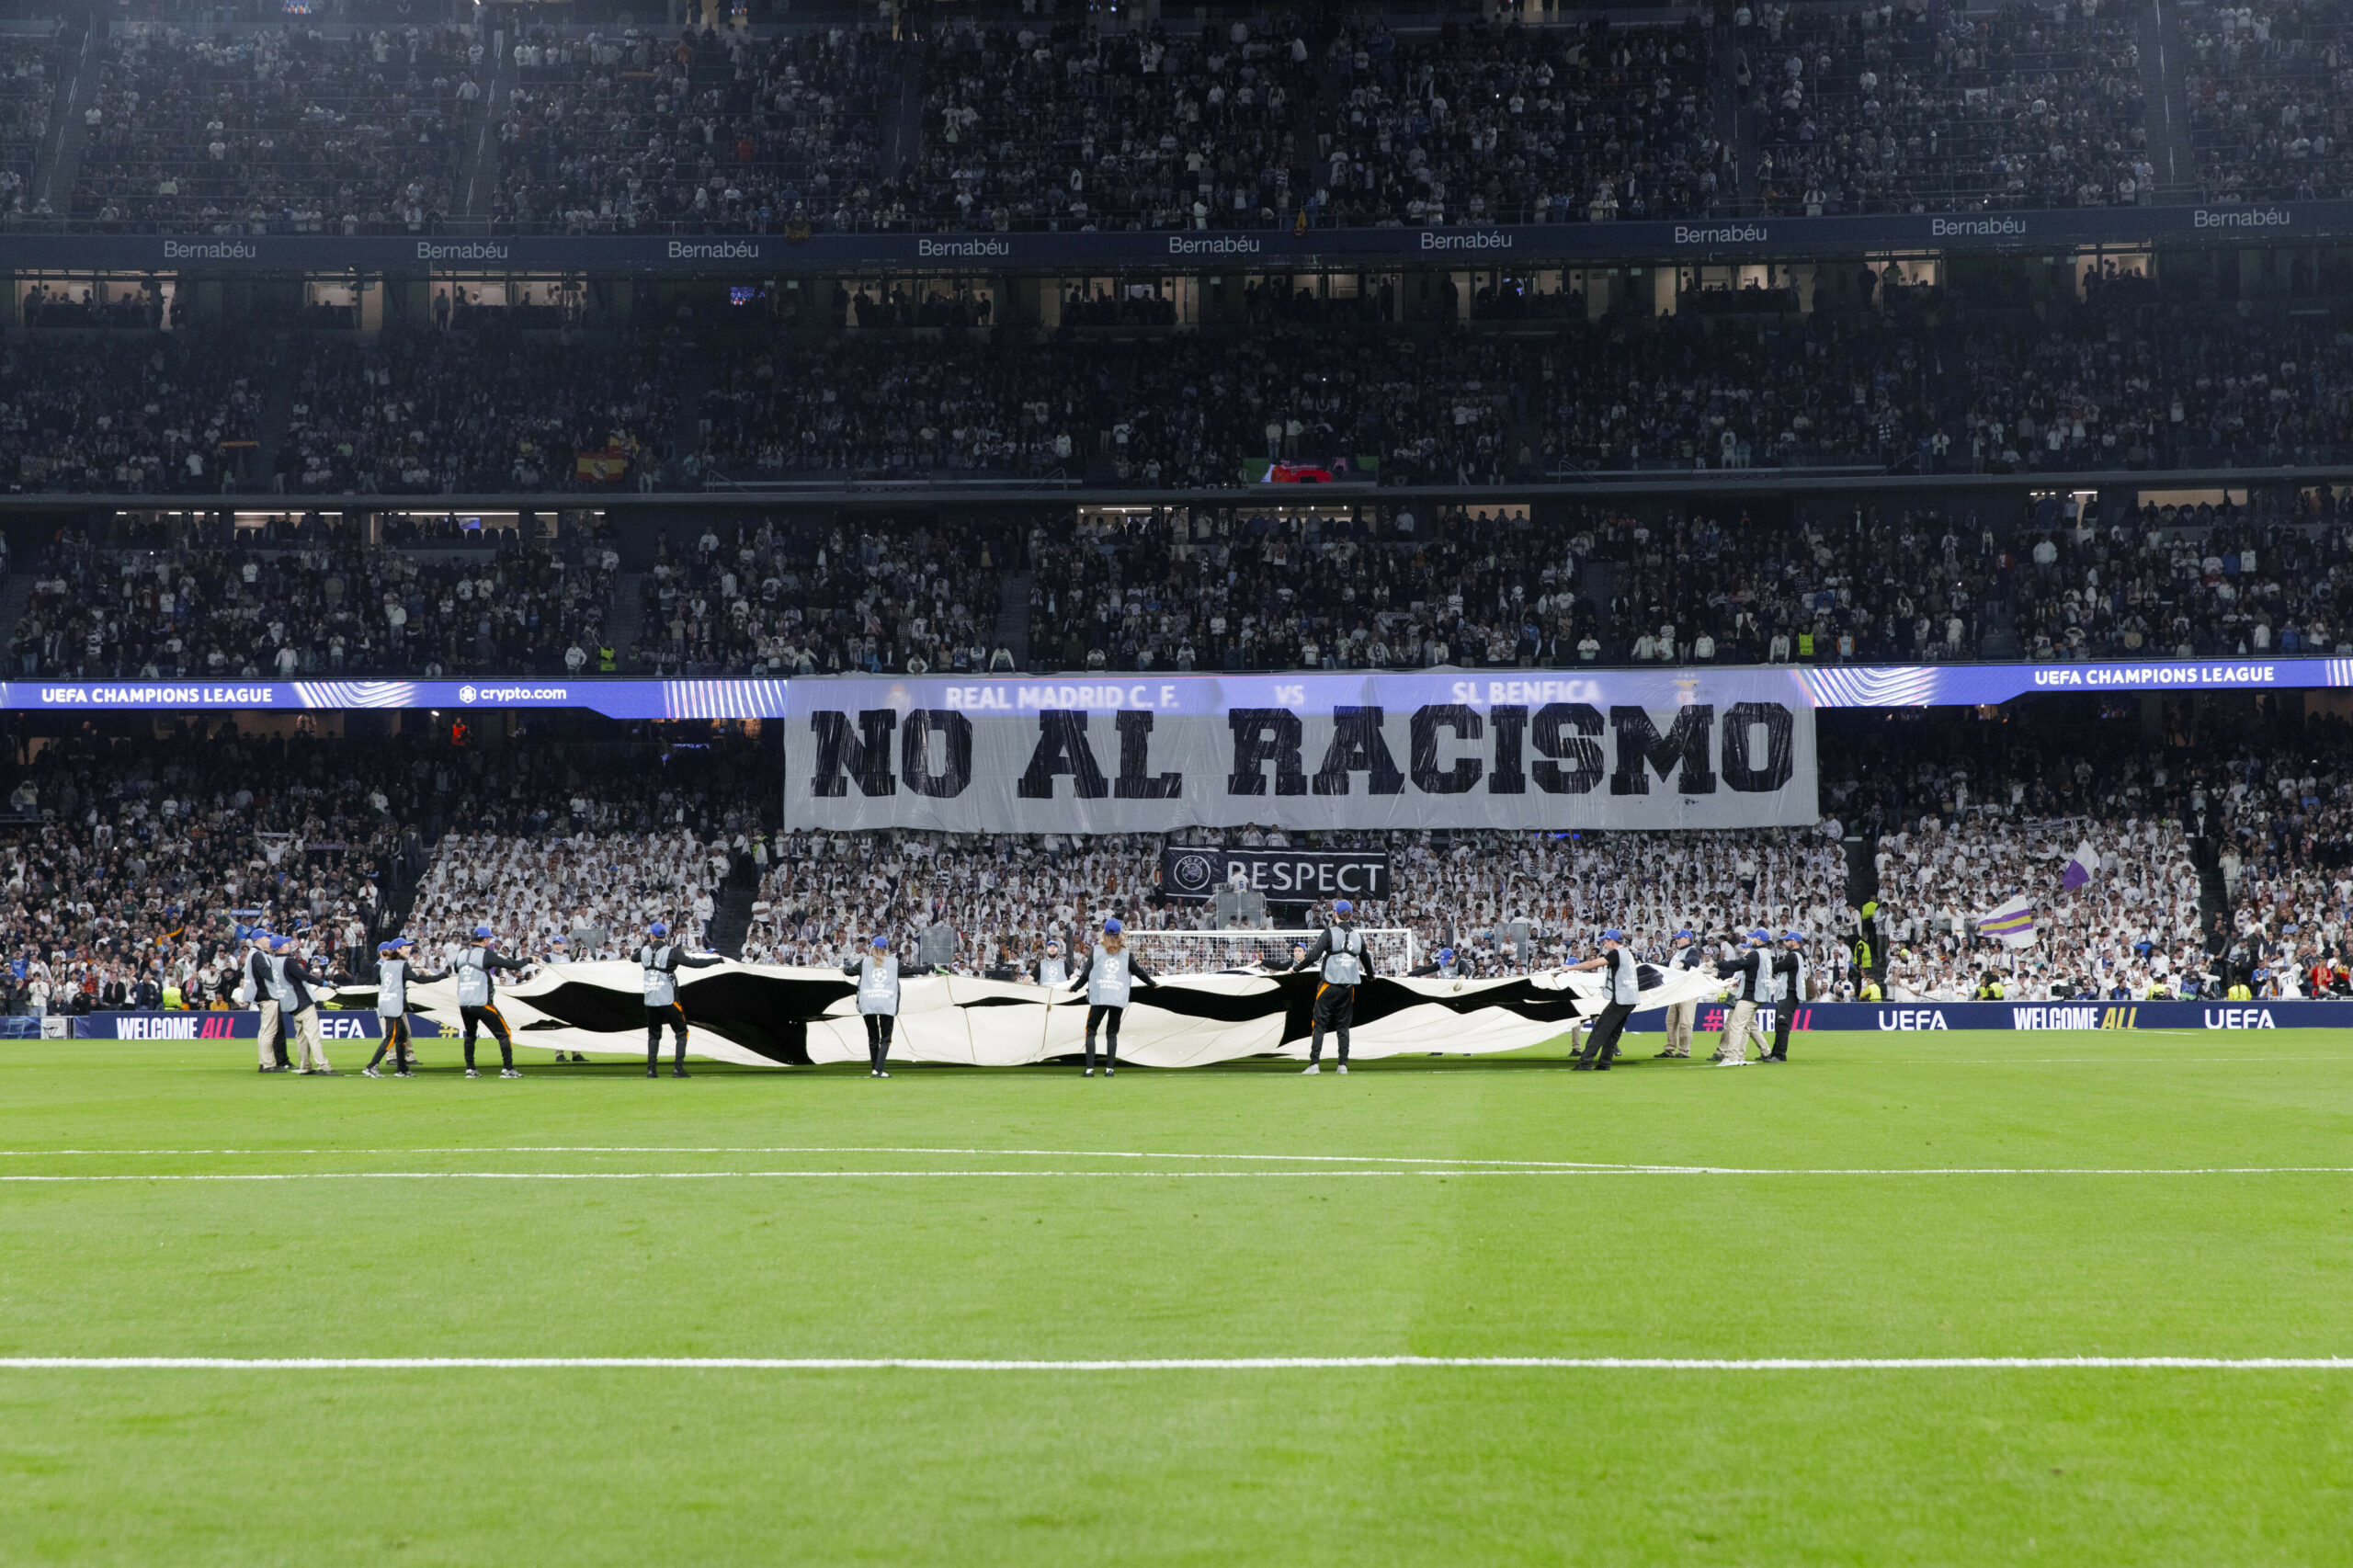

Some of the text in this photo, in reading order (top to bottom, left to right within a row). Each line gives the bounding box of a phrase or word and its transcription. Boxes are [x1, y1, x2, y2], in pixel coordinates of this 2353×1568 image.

[1932, 216, 2026, 236] Bernabéu
[2194, 207, 2290, 228] Bernabéu
[1421, 231, 1512, 249] Bernabéu
[1676, 223, 1768, 244] Bernabéu
[164, 241, 256, 258] Bernabéu
[417, 242, 508, 259] Bernabéu
[668, 241, 759, 258] Bernabéu
[918, 238, 1009, 256] Bernabéu
[1169, 235, 1260, 254] Bernabéu
[2035, 666, 2275, 685] UEFA CHAMPIONS LEAGUE
[41, 687, 273, 702] UEFA CHAMPIONS LEAGUE
[480, 687, 567, 701] crypto.com
[946, 687, 1011, 709] REAL
[1017, 686, 1123, 709] MADRID
[1275, 685, 1304, 705] VS
[1452, 680, 1603, 704] SL BENFICA
[810, 702, 1793, 799] NO AL RACISMO
[1227, 861, 1384, 892] RESPECT
[117, 1017, 235, 1040] WELCOME ALL
[318, 1018, 366, 1039] EFA
[1879, 1010, 1949, 1030] UEFA
[2013, 1007, 2139, 1030] WELCOME ALL
[2204, 1009, 2276, 1029] UEFA
